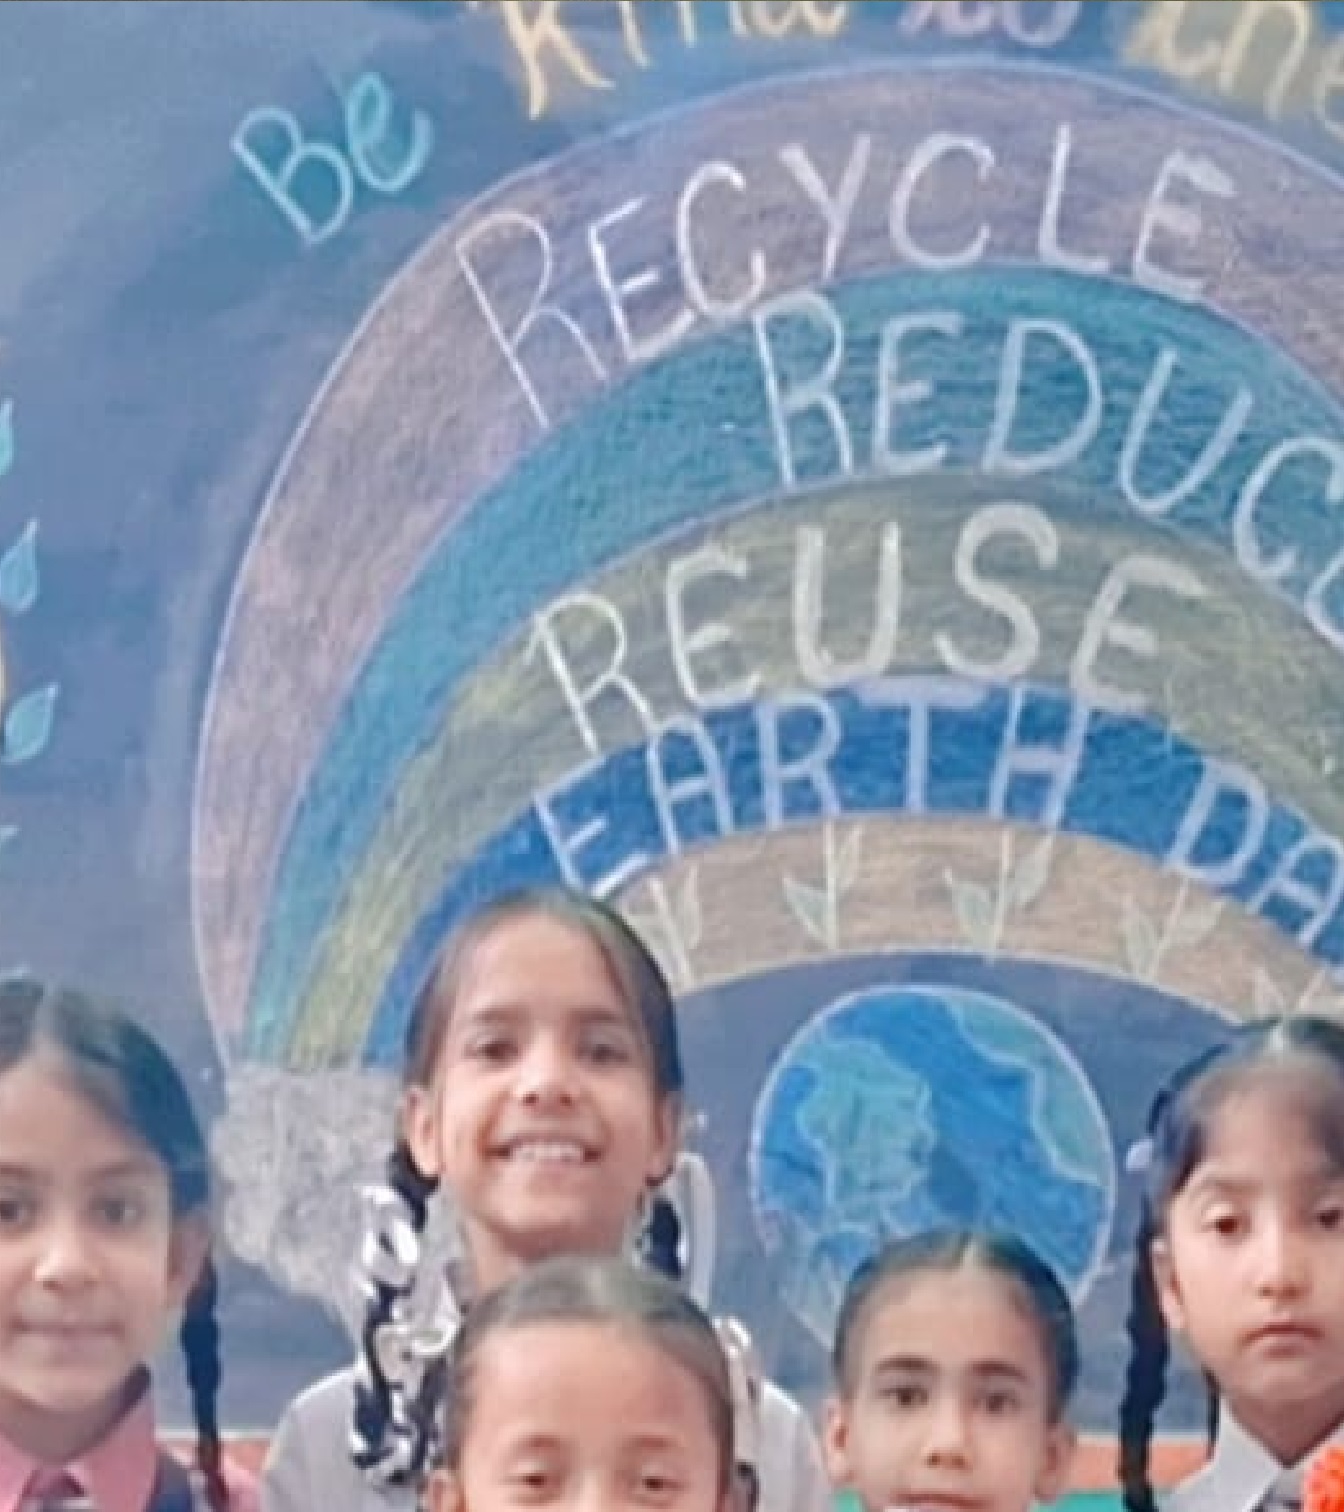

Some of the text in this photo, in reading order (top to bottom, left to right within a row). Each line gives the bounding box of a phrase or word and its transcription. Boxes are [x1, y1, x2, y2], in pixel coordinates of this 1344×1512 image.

[230, 72, 433, 245] Be
[453, 122, 1237, 430] RECYCLE
[525, 502, 1212, 756] REUSE
[533, 676, 1090, 897] EARTH
